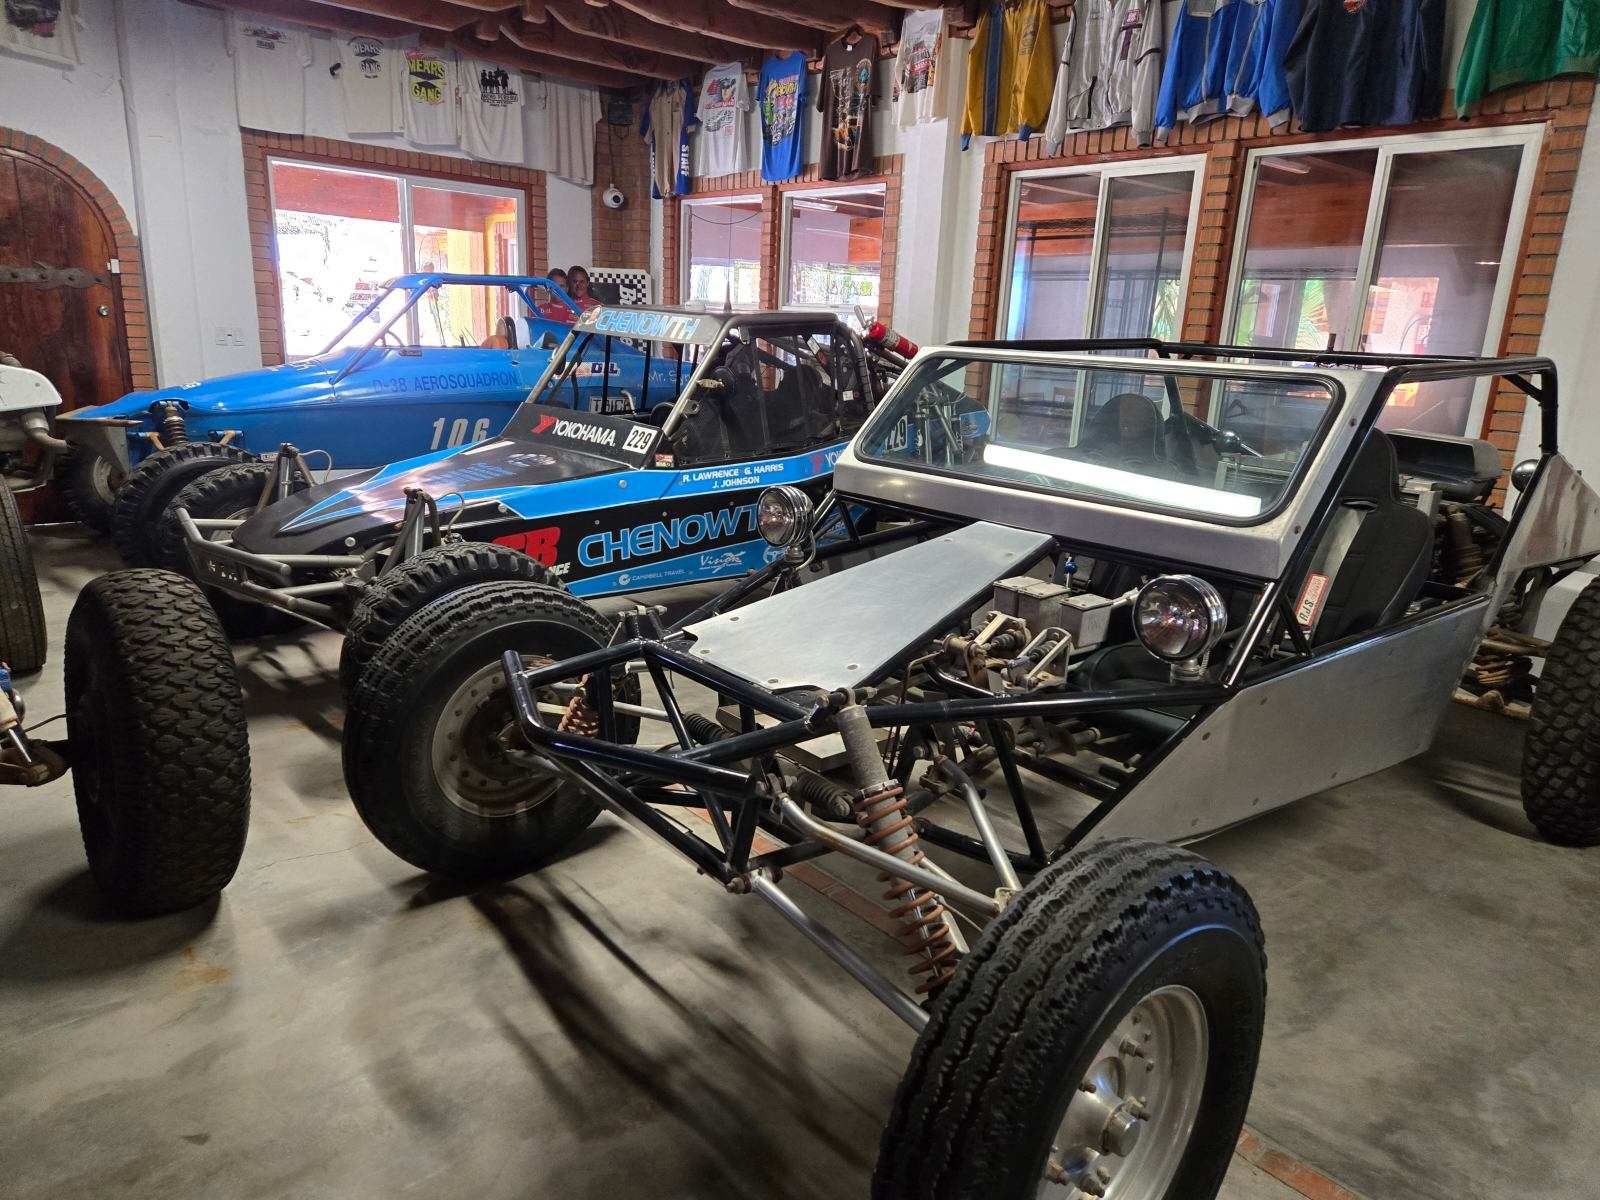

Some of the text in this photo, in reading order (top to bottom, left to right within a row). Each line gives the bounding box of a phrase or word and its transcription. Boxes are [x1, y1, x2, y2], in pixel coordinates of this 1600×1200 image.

[408, 59, 445, 78] MEARS
[412, 84, 442, 102] GANG
[681, 144, 689, 176] STAFF
[595, 310, 701, 340] CHENOWTH
[414, 371, 517, 391] AEROSQUADRON
[430, 418, 490, 450] 106
[552, 419, 615, 446] YOKOHAMA
[626, 430, 652, 450] 229
[682, 463, 784, 483] R. LAWRENCE G. HARRIS
[720, 476, 760, 488] JOHNSON
[577, 503, 758, 568] CHENOWT
[632, 569, 685, 581] CAMPBELL TRAVEL
